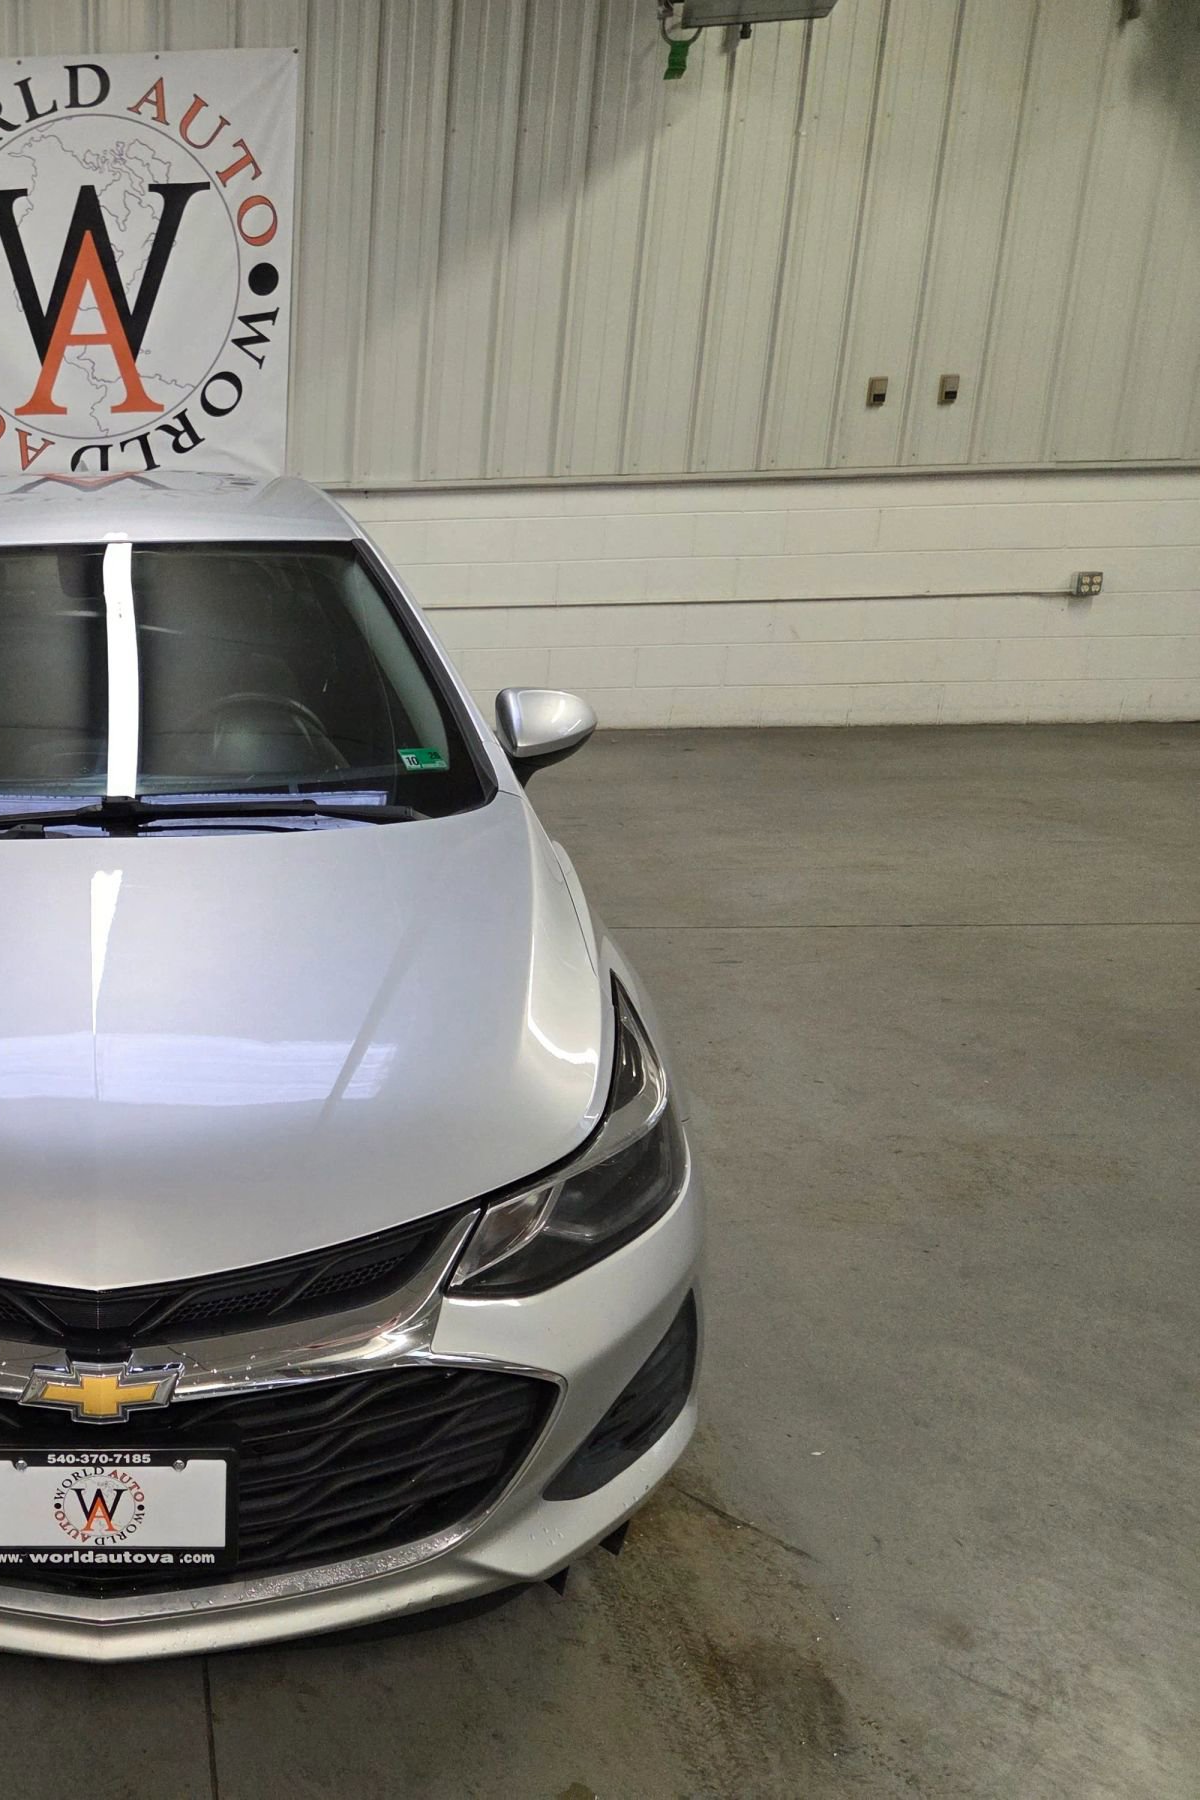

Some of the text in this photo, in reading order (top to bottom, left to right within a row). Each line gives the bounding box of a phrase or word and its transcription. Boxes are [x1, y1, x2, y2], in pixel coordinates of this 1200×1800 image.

[127, 76, 279, 247] AUTO
[70, 306, 280, 472] WORLD
[47, 1453, 151, 1464] 540-370-7185
[54, 1466, 145, 1502] WORLD AUTO
[54, 1510, 145, 1546] WORLD AUTO
